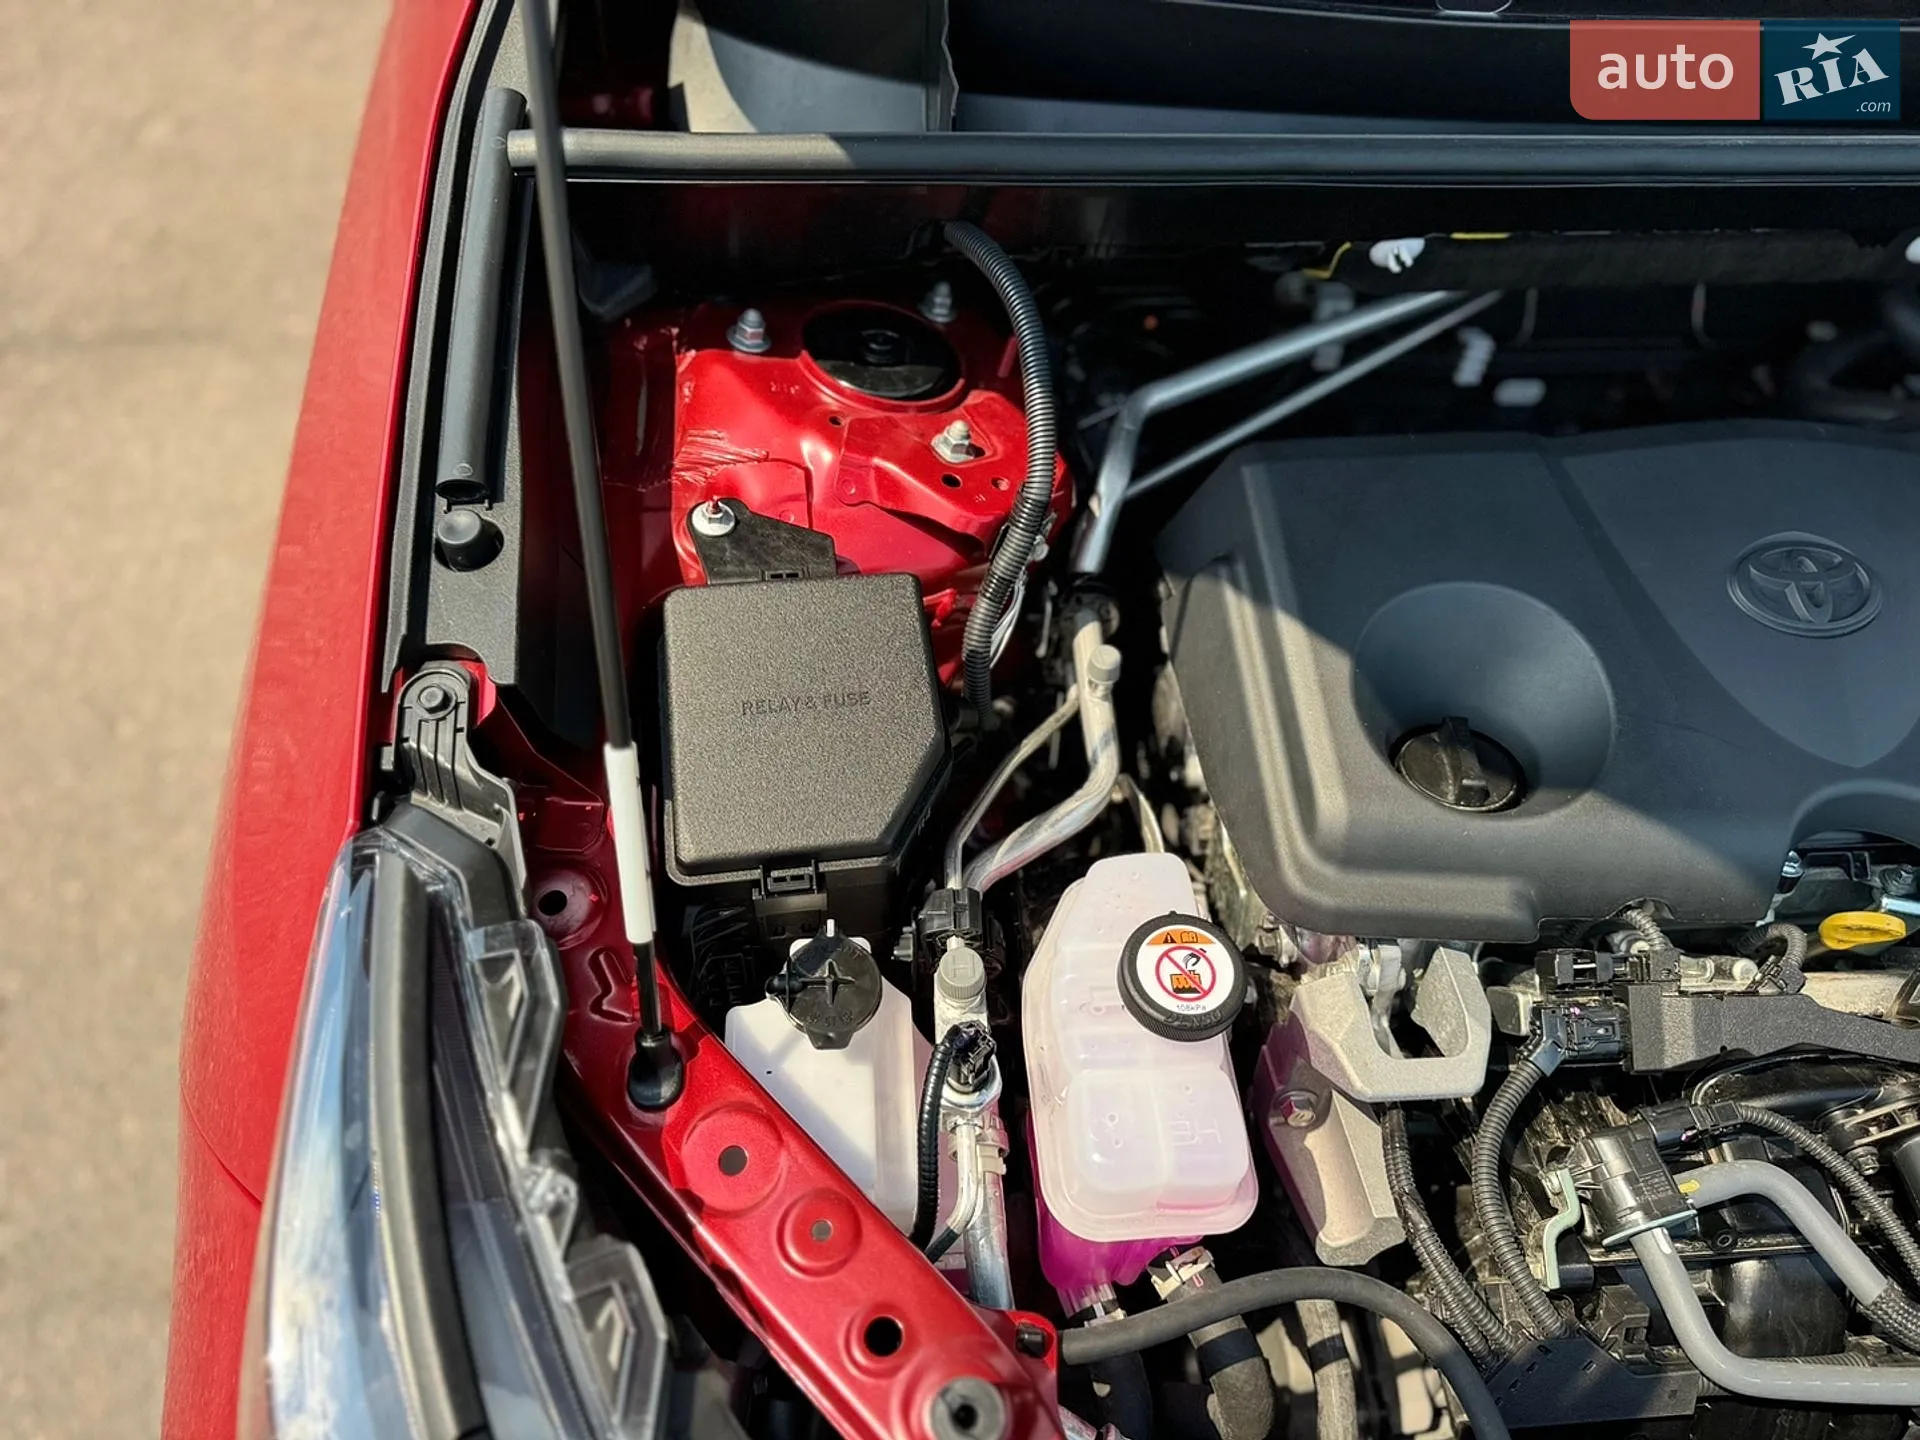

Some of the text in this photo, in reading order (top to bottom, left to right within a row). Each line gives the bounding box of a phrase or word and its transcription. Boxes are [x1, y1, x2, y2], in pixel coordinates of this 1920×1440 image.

[742, 691, 871, 716] RELAY & FUSE
